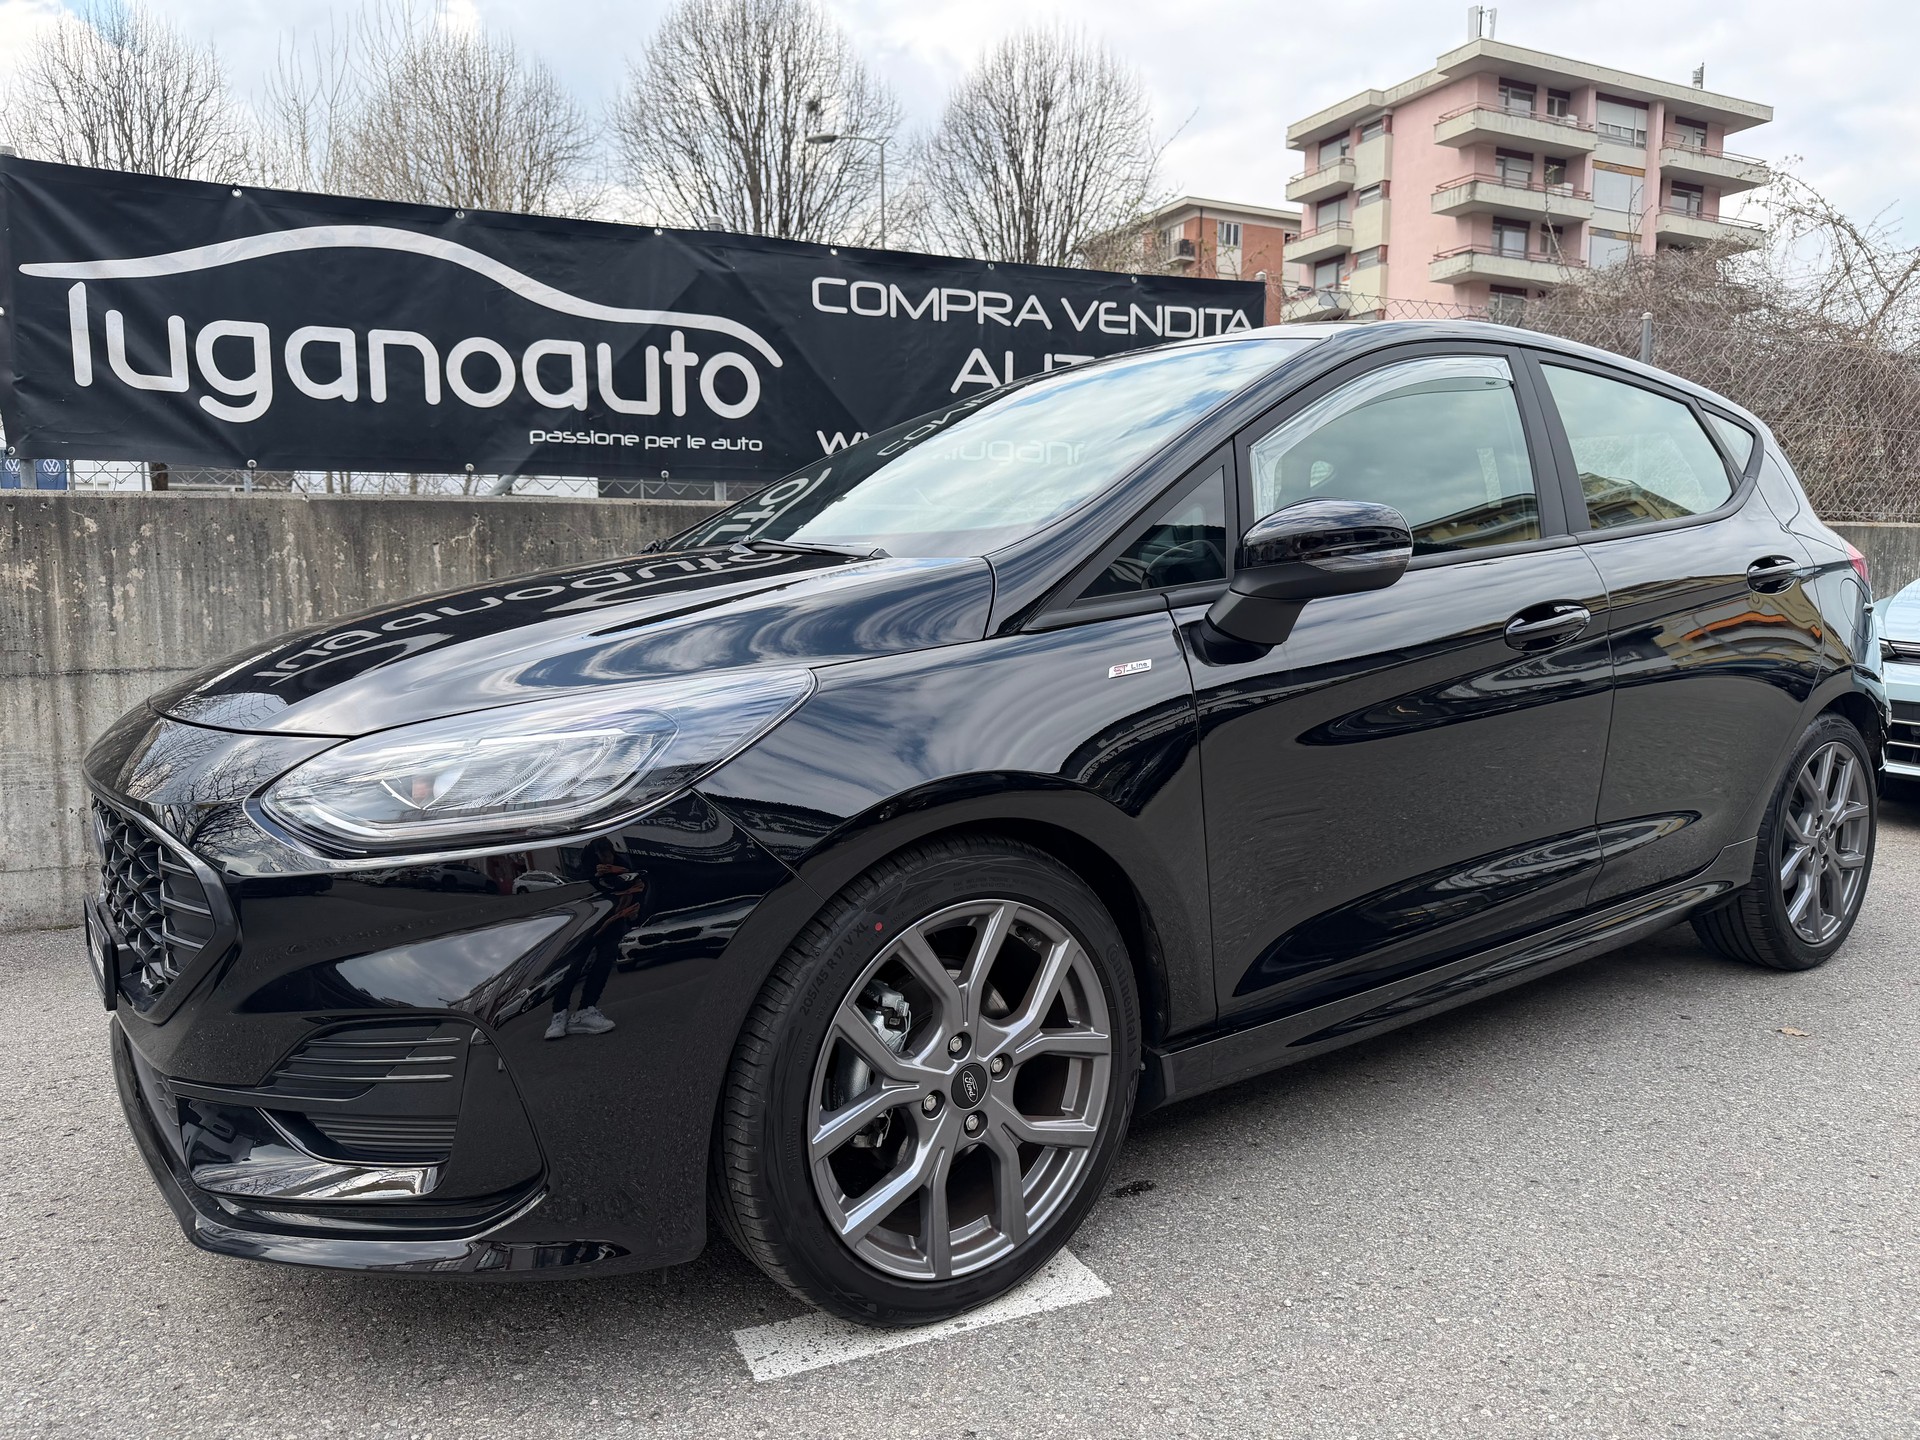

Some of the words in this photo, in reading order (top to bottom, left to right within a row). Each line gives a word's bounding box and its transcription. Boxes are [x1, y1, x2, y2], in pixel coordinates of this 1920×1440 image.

[811, 276, 1053, 331] COMPRA
[1060, 297, 1252, 338] VENDITA
[68, 282, 761, 423] luganoauto
[529, 429, 639, 447] passione
[645, 435, 681, 450] per
[687, 434, 706, 449] le
[711, 436, 763, 452] auto
[800, 969, 829, 1016] 205/45
[827, 958, 838, 970] R
[833, 945, 845, 960] 17
[852, 921, 870, 938] XL
